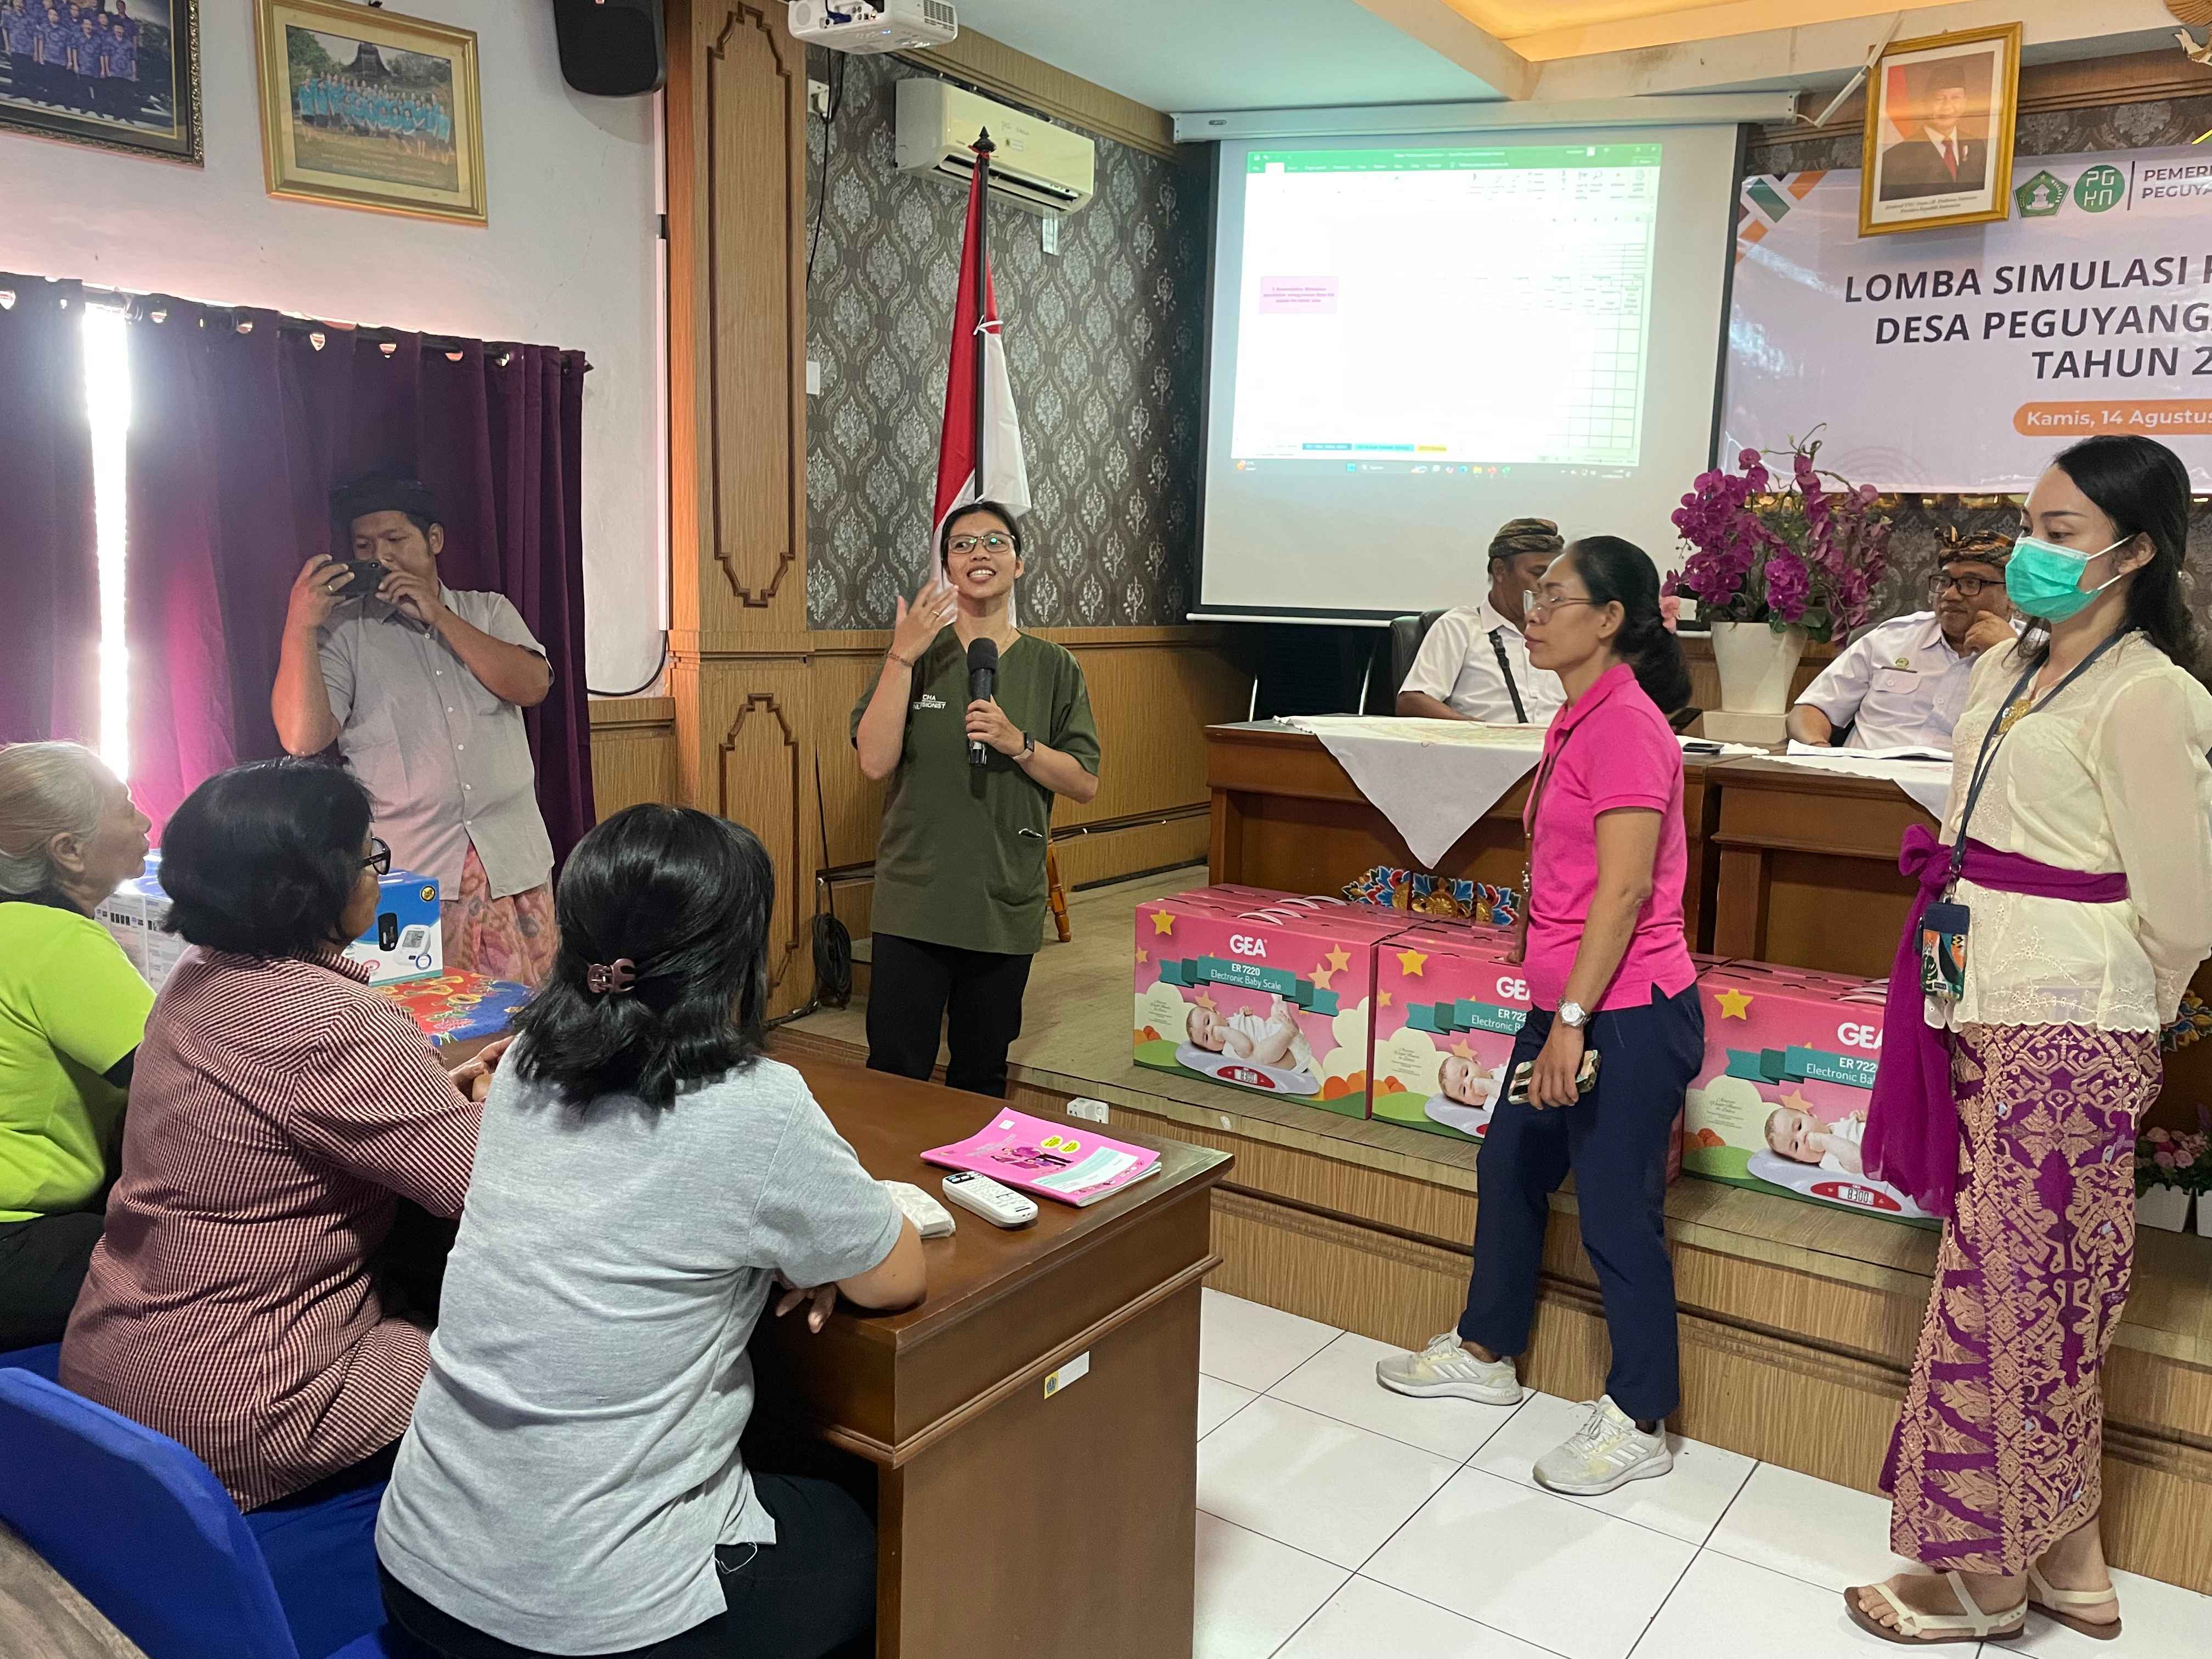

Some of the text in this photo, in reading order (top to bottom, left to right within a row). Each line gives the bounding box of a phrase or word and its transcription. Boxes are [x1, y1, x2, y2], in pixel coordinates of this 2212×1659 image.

[1845, 268, 1981, 302] LOMBA
[1993, 256, 2187, 294] SIMULASI
[1876, 302, 2212, 344] DESA PEGUYANG
[2032, 347, 2179, 379] TAHUN
[2027, 410, 2095, 428] Kamis,
[2101, 410, 2123, 425] 14
[1229, 934, 1266, 957] GEA
[1232, 963, 1260, 976] ER 7220
[1211, 969, 1282, 990] Electronic Baby Scale
[1496, 977, 1530, 1001] GE
[1471, 1014, 1513, 1031] Electronic
[1498, 1008, 1526, 1022] ER 722
[1807, 1063, 1857, 1082] Electronic
[1839, 1057, 1878, 1073] ER 722
[1848, 1188, 1869, 1203] 8300
